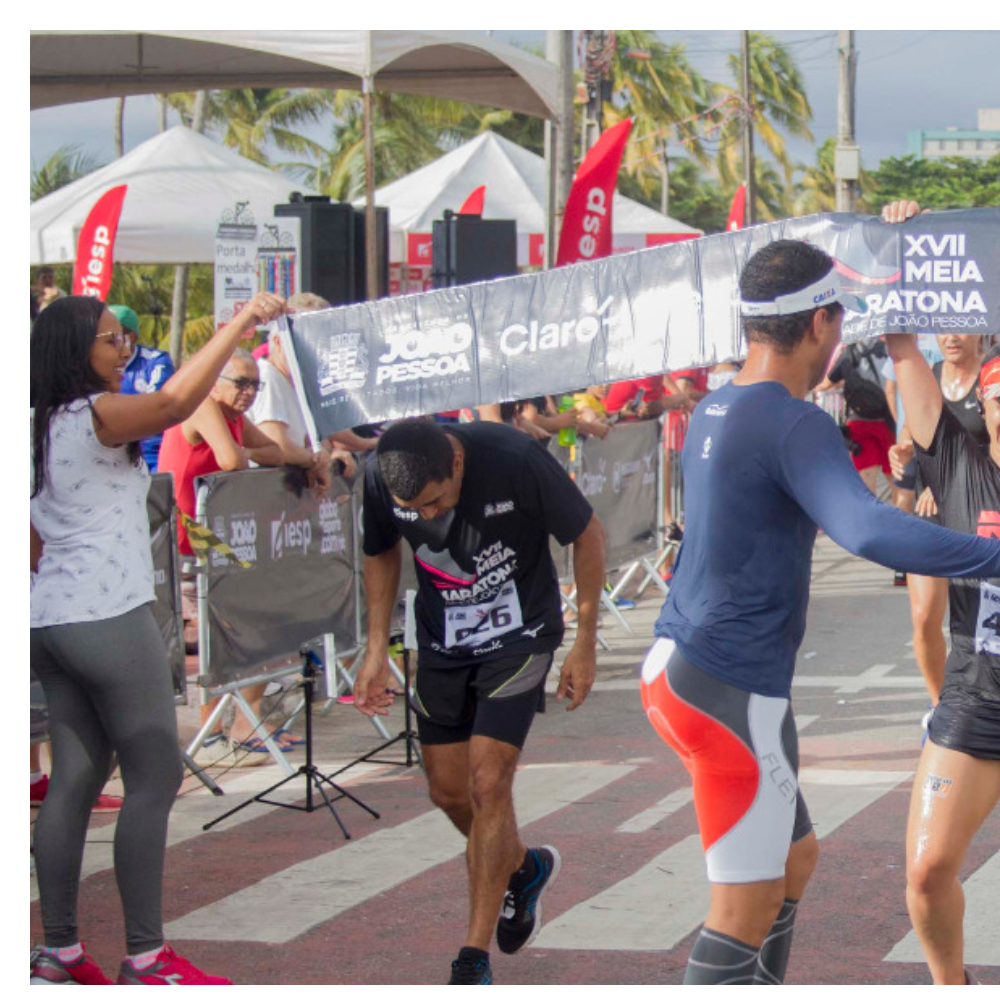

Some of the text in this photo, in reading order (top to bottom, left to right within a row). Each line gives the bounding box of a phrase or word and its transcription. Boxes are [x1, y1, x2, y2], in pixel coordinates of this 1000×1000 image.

[577, 187, 606, 259] esp
[86, 226, 109, 284] iesp
[217, 246, 246, 257] Porta
[904, 234, 966, 257] XVII
[217, 262, 256, 274] medalh
[904, 261, 985, 283] MEIA
[862, 289, 988, 314] RATONA
[889, 313, 929, 328] JOÃO
[931, 316, 988, 328] PESSOA
[500, 316, 600, 357] Claro
[376, 353, 471, 386] PESSOA
[284, 518, 312, 556] iesp
[231, 544, 257, 562] ESSOA
[473, 540, 503, 565] XVII
[476, 547, 516, 577] MEIA
